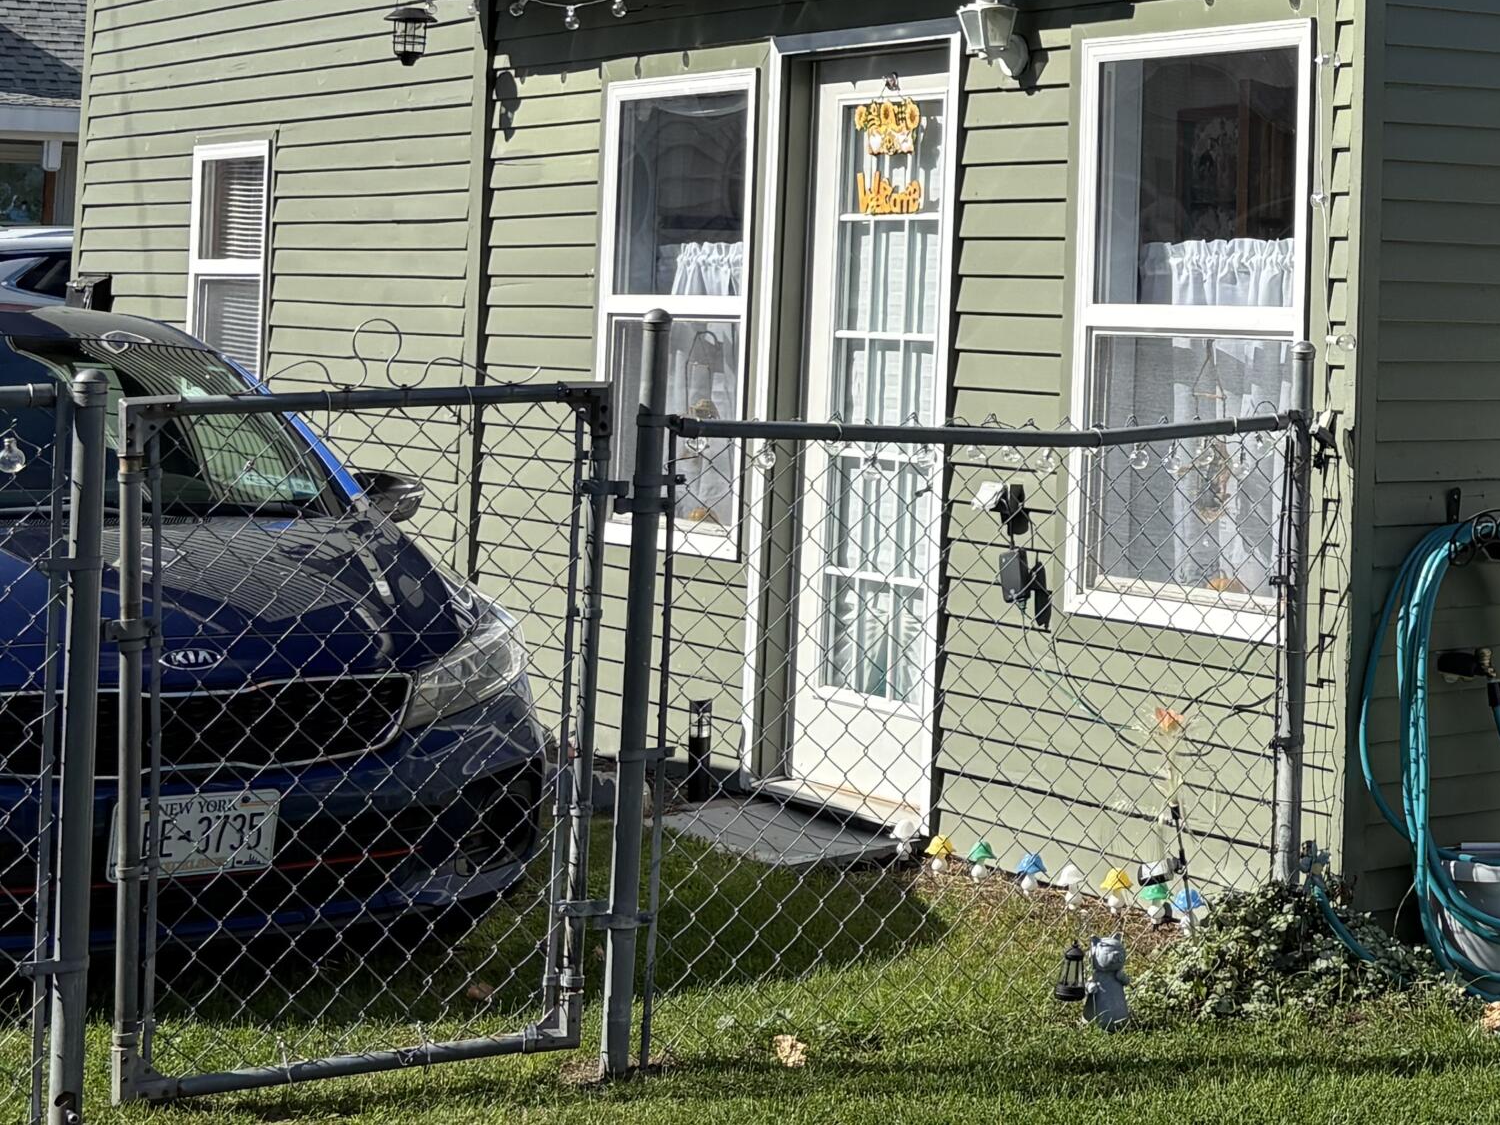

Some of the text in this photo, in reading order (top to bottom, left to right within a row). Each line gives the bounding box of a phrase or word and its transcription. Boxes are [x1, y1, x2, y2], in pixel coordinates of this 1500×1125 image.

[857, 171, 921, 215] Welcome
[171, 651, 213, 665] KIA
[158, 798, 238, 816] NEW YORK
